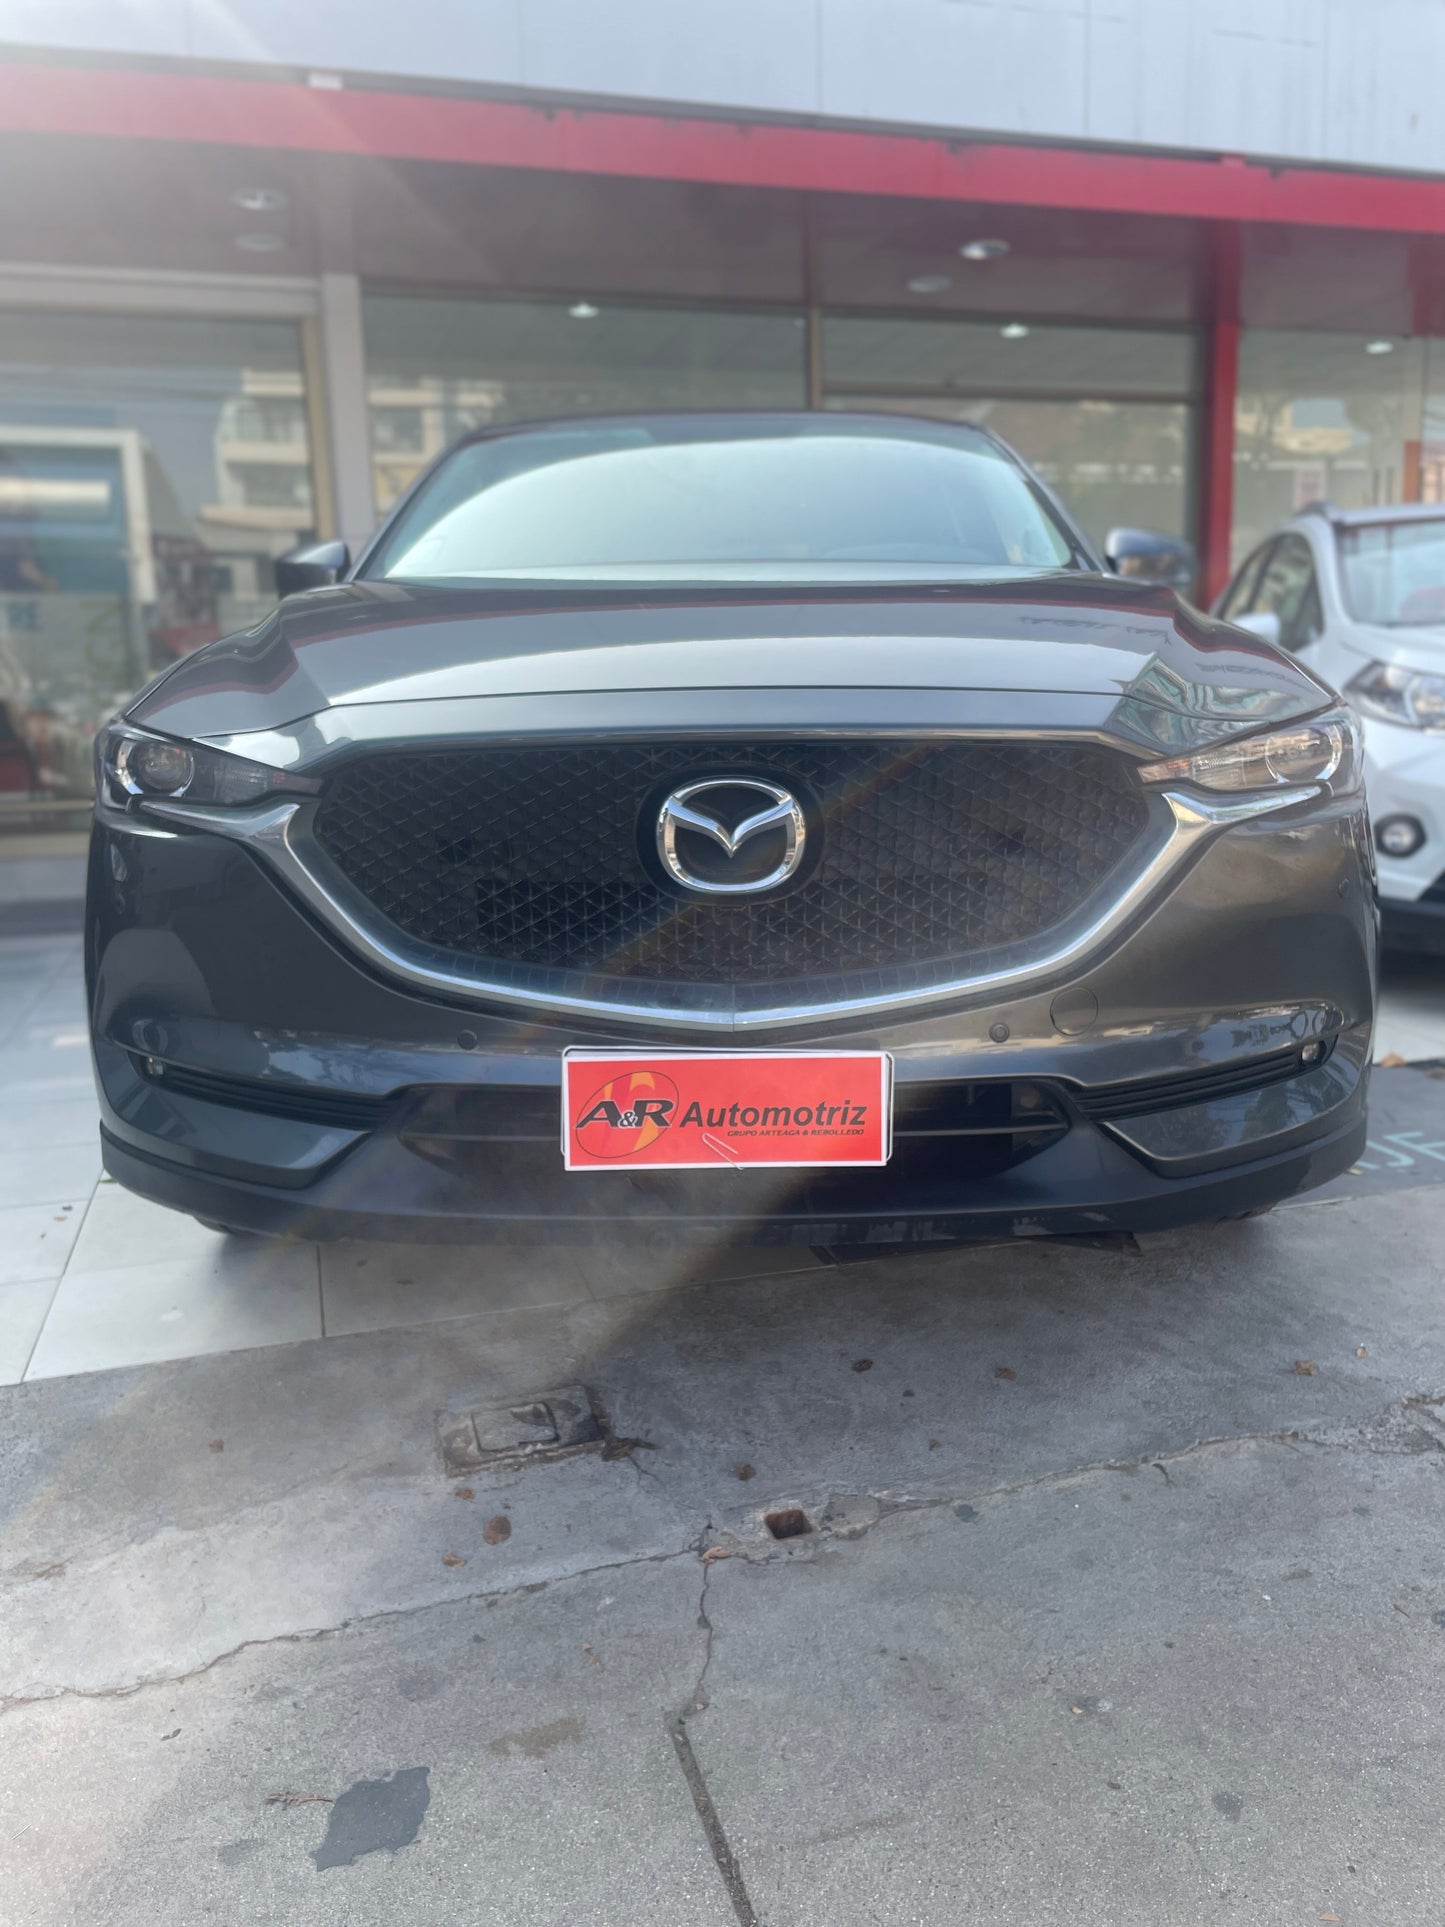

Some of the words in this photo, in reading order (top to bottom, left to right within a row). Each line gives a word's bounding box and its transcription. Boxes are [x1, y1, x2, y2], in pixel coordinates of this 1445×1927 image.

[575, 1099, 674, 1129] A&R
[679, 1099, 868, 1128] Automotriz
[727, 1129, 758, 1137] GRUPO
[758, 1129, 800, 1137] ARTEAGA
[801, 1129, 809, 1137] &
[811, 1128, 865, 1136] REBOLLEDO
